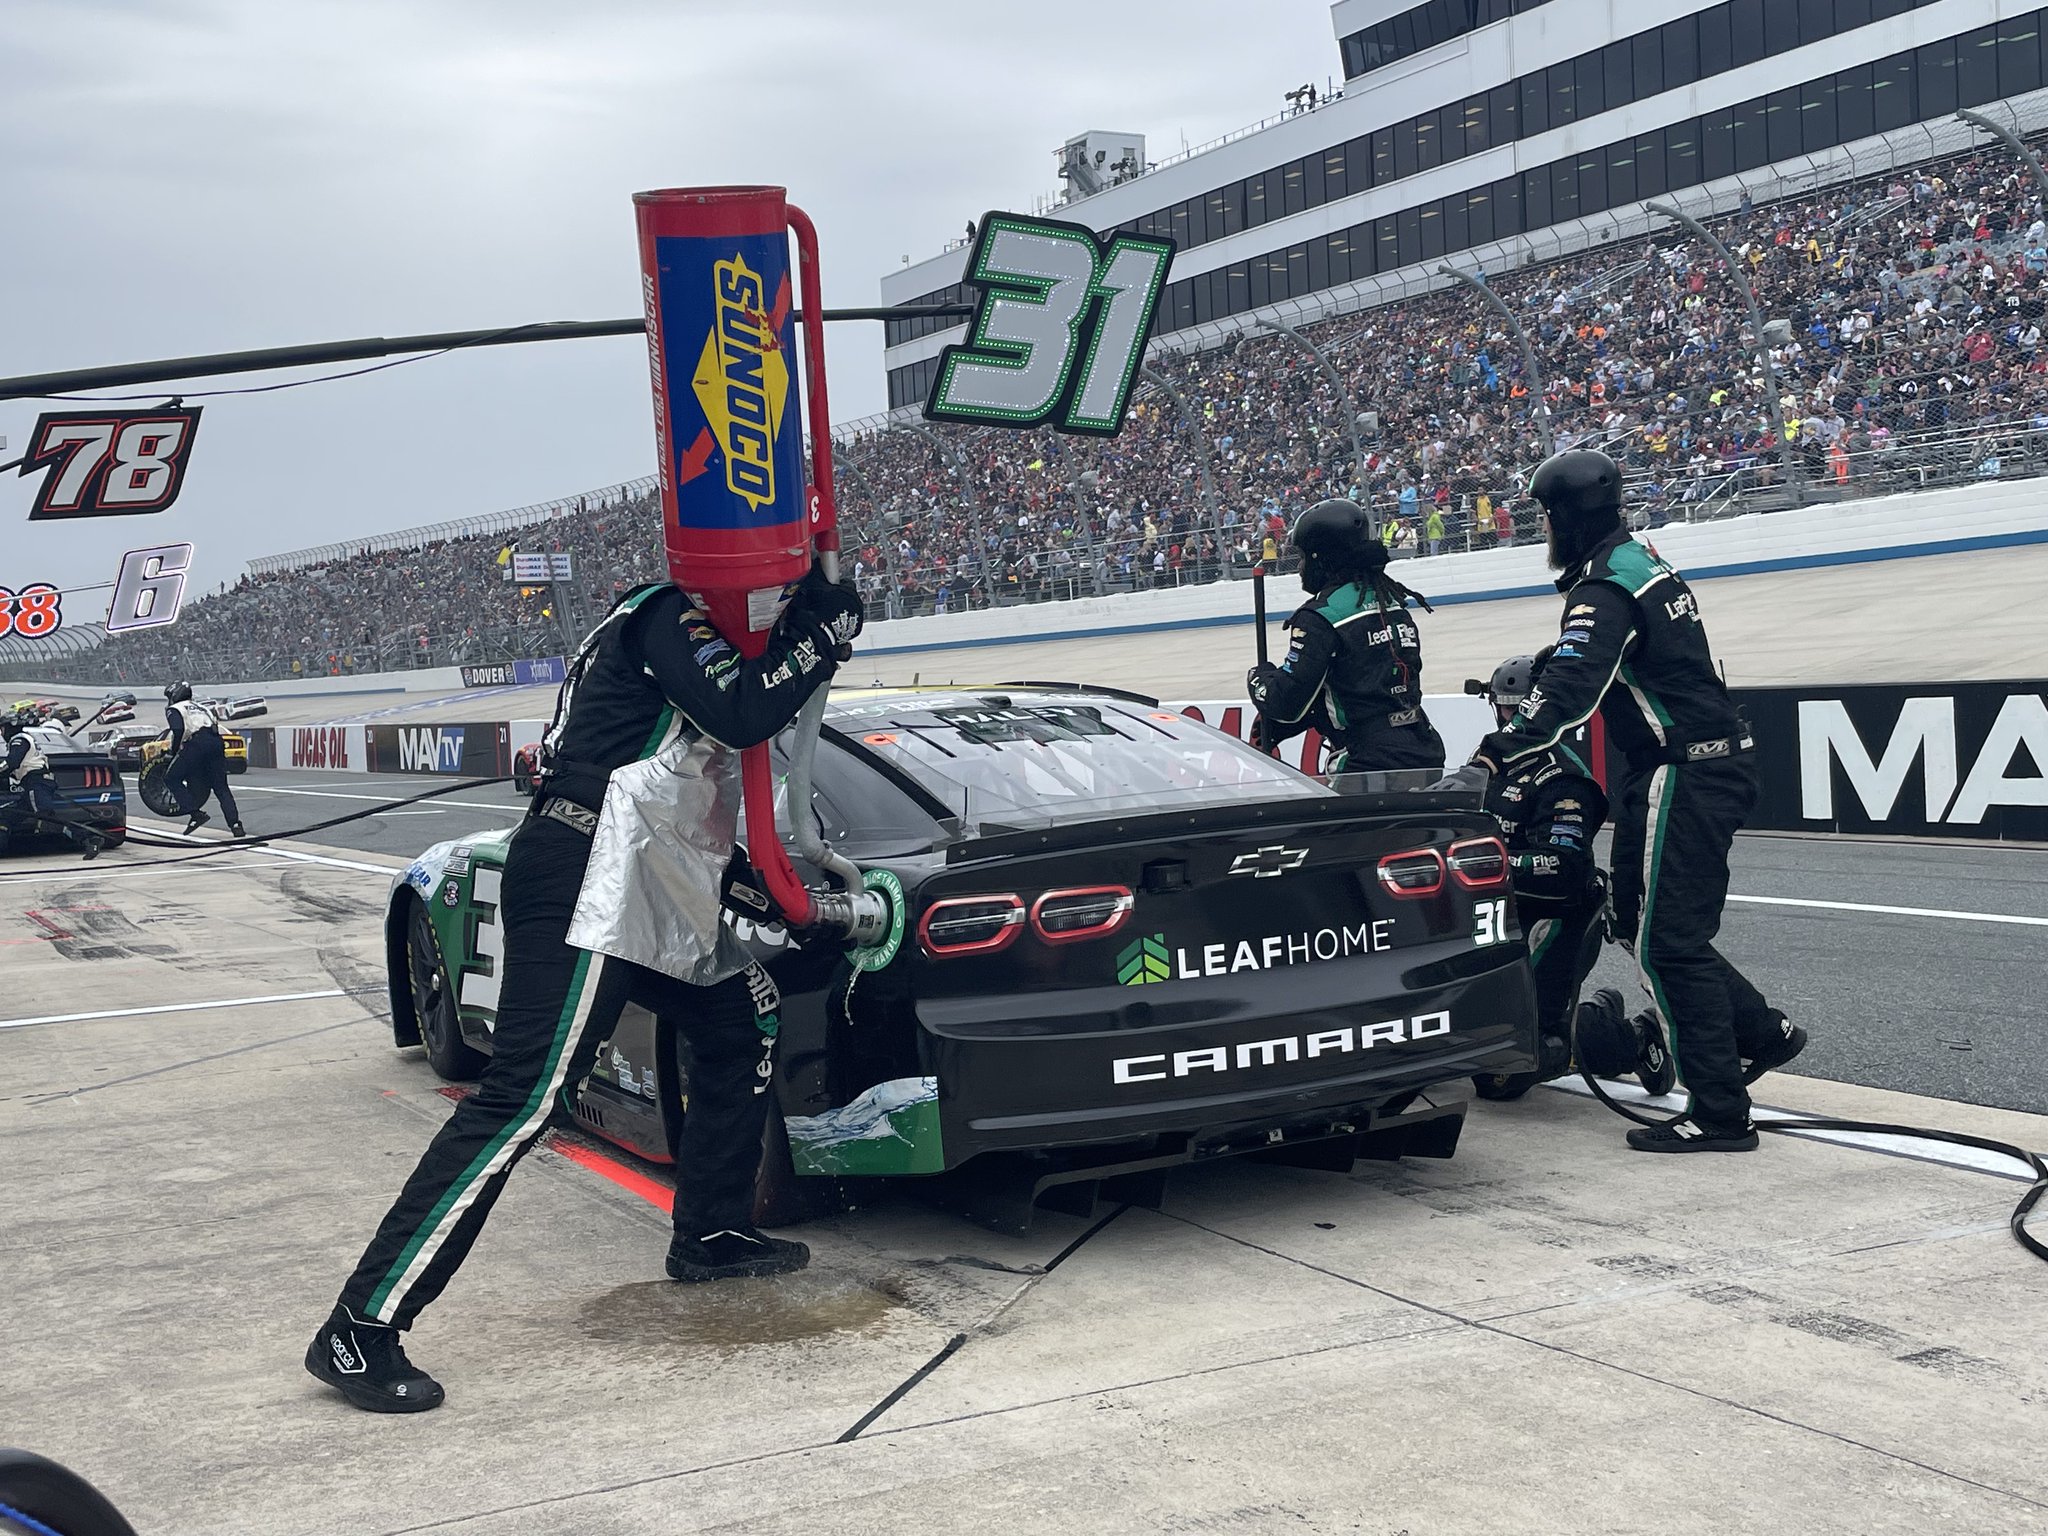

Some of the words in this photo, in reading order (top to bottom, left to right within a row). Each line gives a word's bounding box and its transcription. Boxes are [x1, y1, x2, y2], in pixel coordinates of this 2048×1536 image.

[643, 272, 660, 357] NASCAR
[934, 218, 1171, 430] 31
[719, 267, 770, 498] SUNOCO
[36, 418, 190, 511] 78
[105, 542, 194, 634] 6
[1367, 624, 1393, 647] Leaf
[472, 667, 505, 684] DOVER
[530, 660, 553, 682] xfinity
[761, 661, 793, 690] Leaf
[500, 727, 507, 743] 21
[944, 707, 1078, 723] HALEY
[292, 727, 327, 768] LUCAS
[329, 727, 348, 769] OIL
[99, 793, 111, 803] 6
[862, 872, 902, 911] BIOETHANOL
[1474, 898, 1508, 946] 31
[1113, 1010, 1451, 1084] CAMARO
